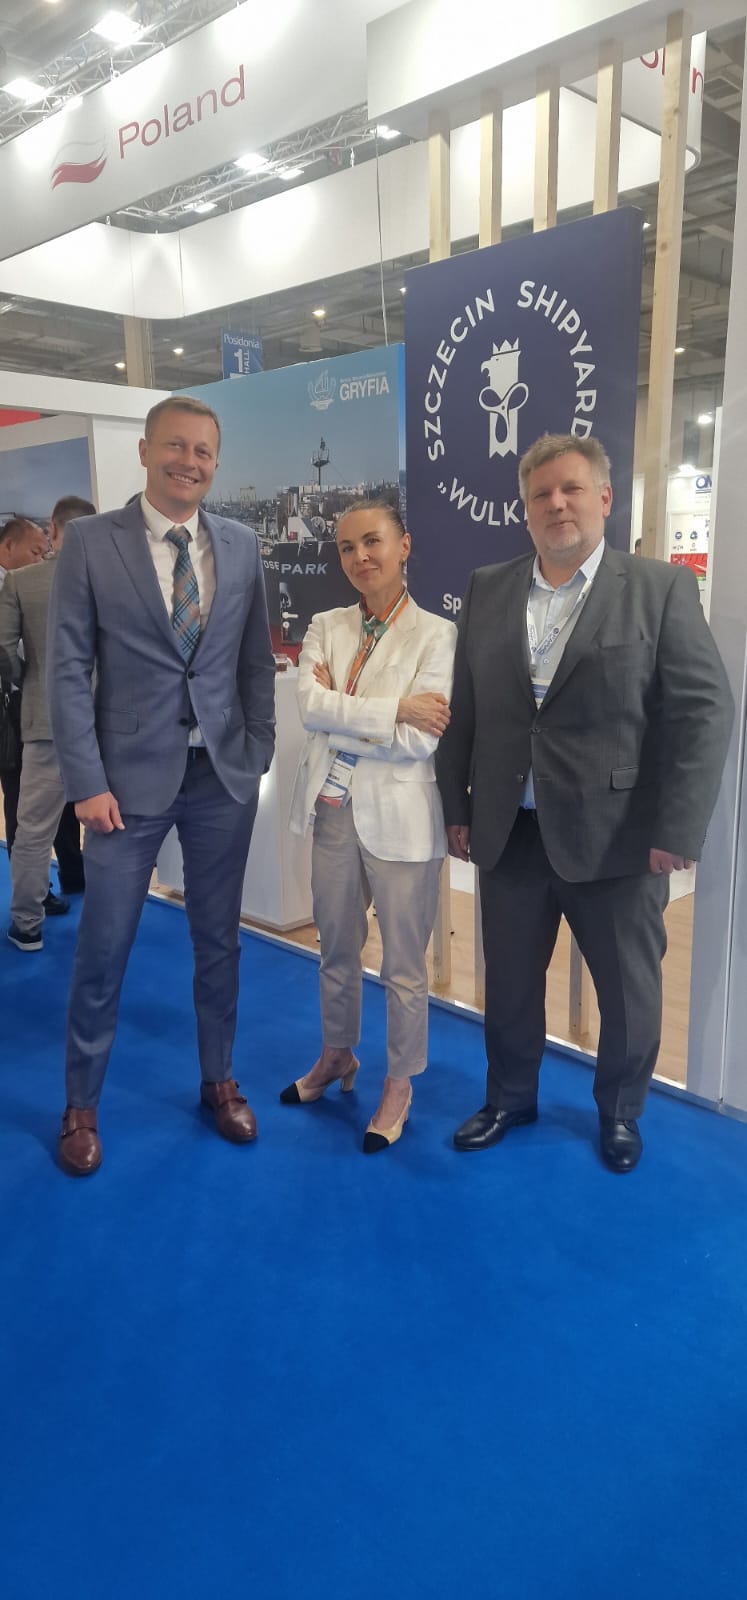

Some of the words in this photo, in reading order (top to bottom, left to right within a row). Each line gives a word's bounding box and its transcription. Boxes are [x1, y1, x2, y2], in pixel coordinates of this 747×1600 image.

[118, 64, 245, 159] Poland
[224, 333, 260, 348] Posidonia
[424, 288, 495, 461] SZCZECIN
[517, 280, 597, 440] SHIPYARD
[340, 376, 390, 401] GRYFIA
[281, 562, 328, 575] PARK
